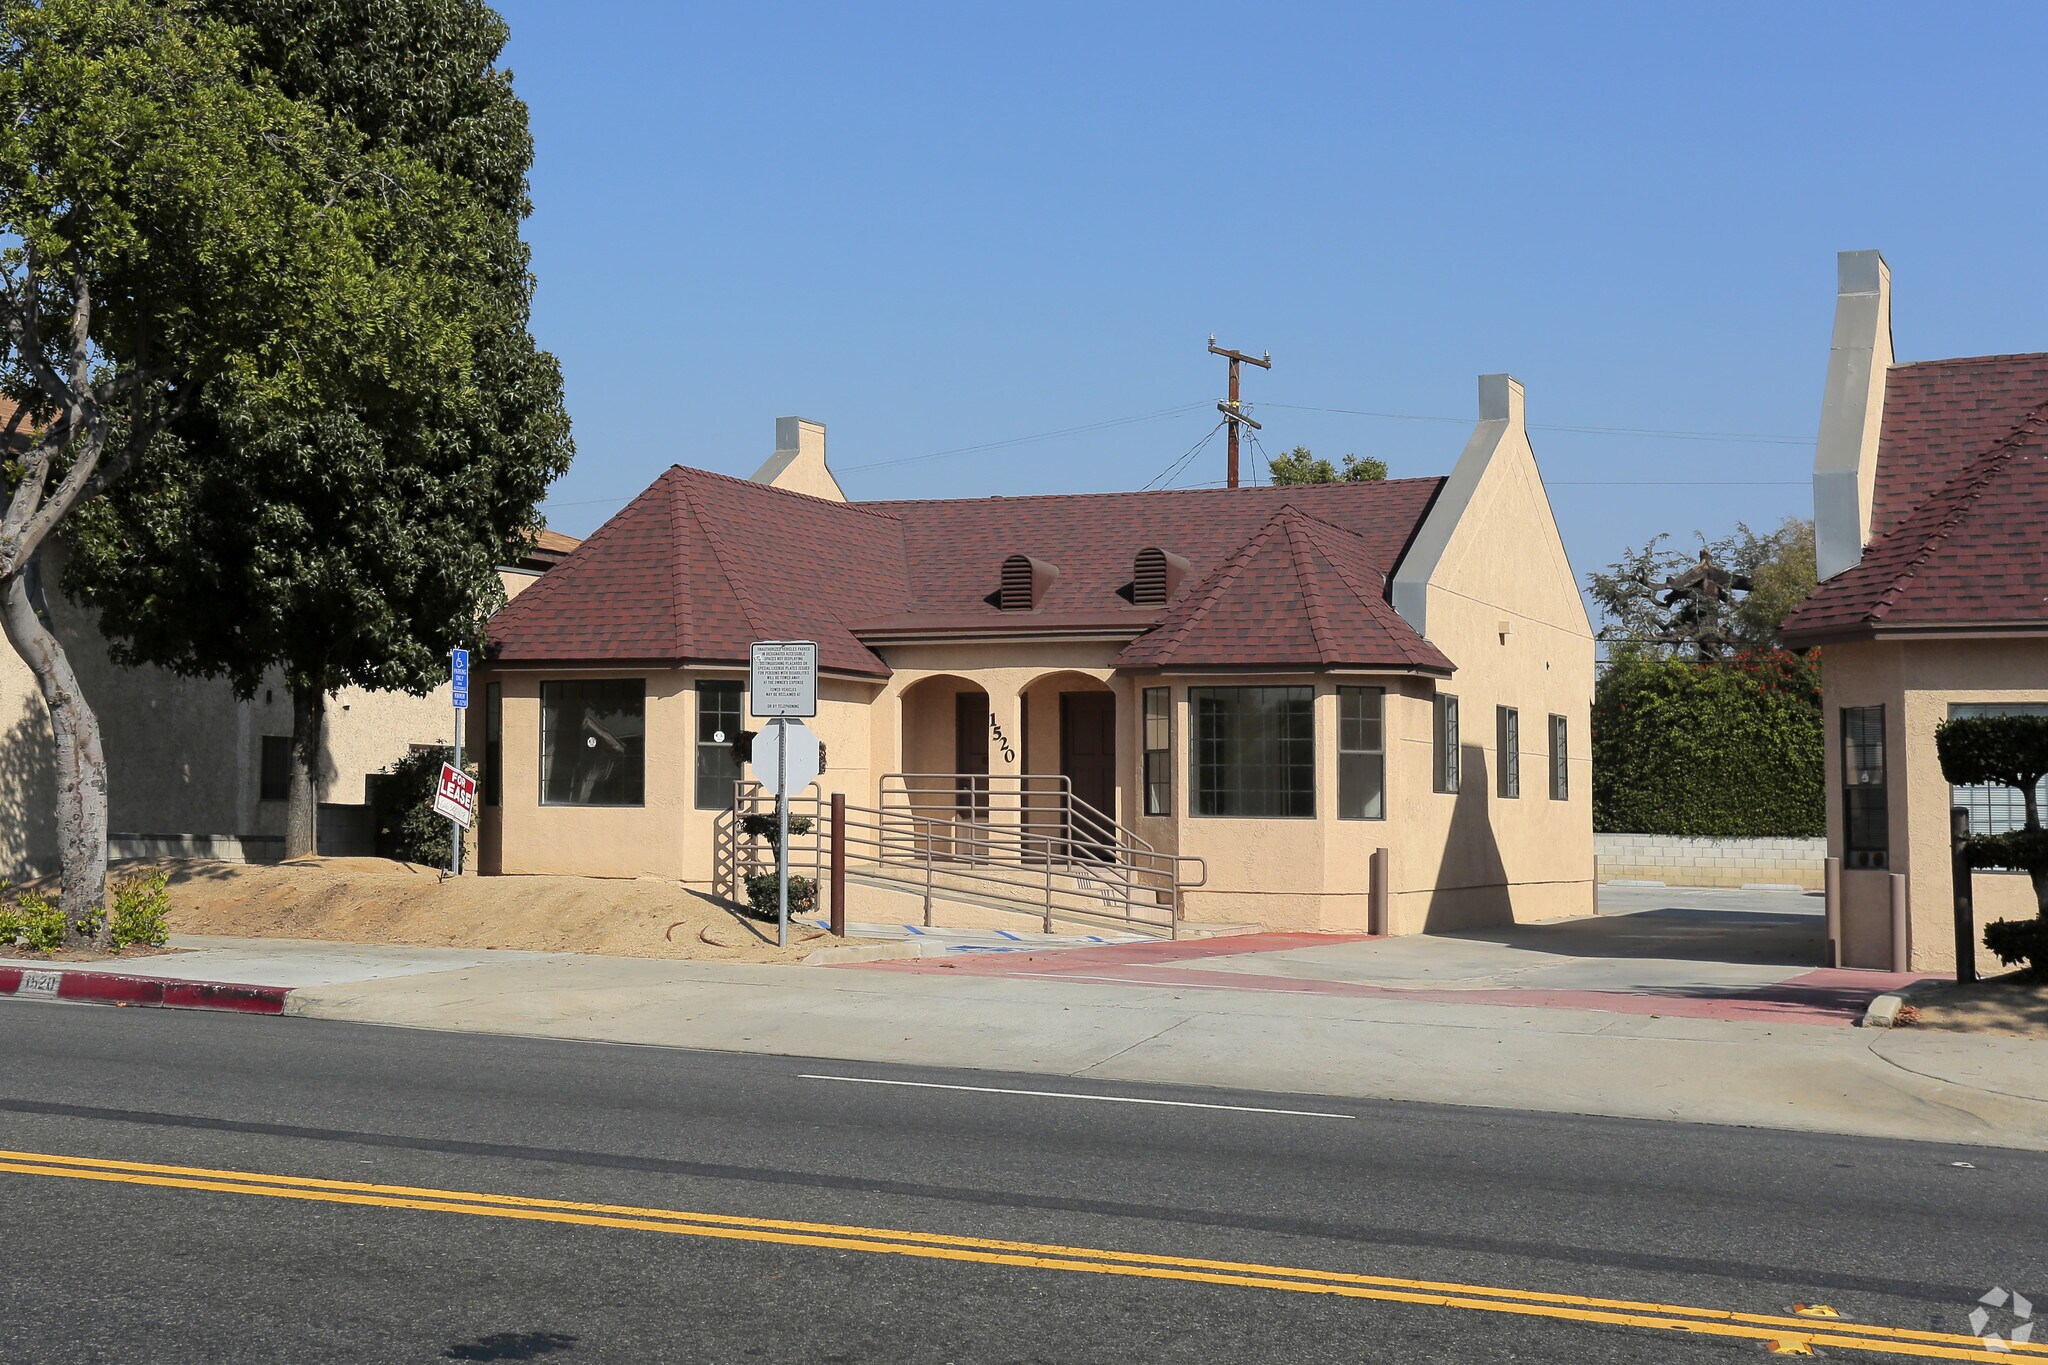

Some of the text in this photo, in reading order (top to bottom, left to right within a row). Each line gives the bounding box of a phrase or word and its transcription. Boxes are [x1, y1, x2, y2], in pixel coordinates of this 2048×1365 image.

[990, 712, 1015, 763] 1520
[440, 778, 471, 808] LEASE
[451, 772, 466, 788] FOR
